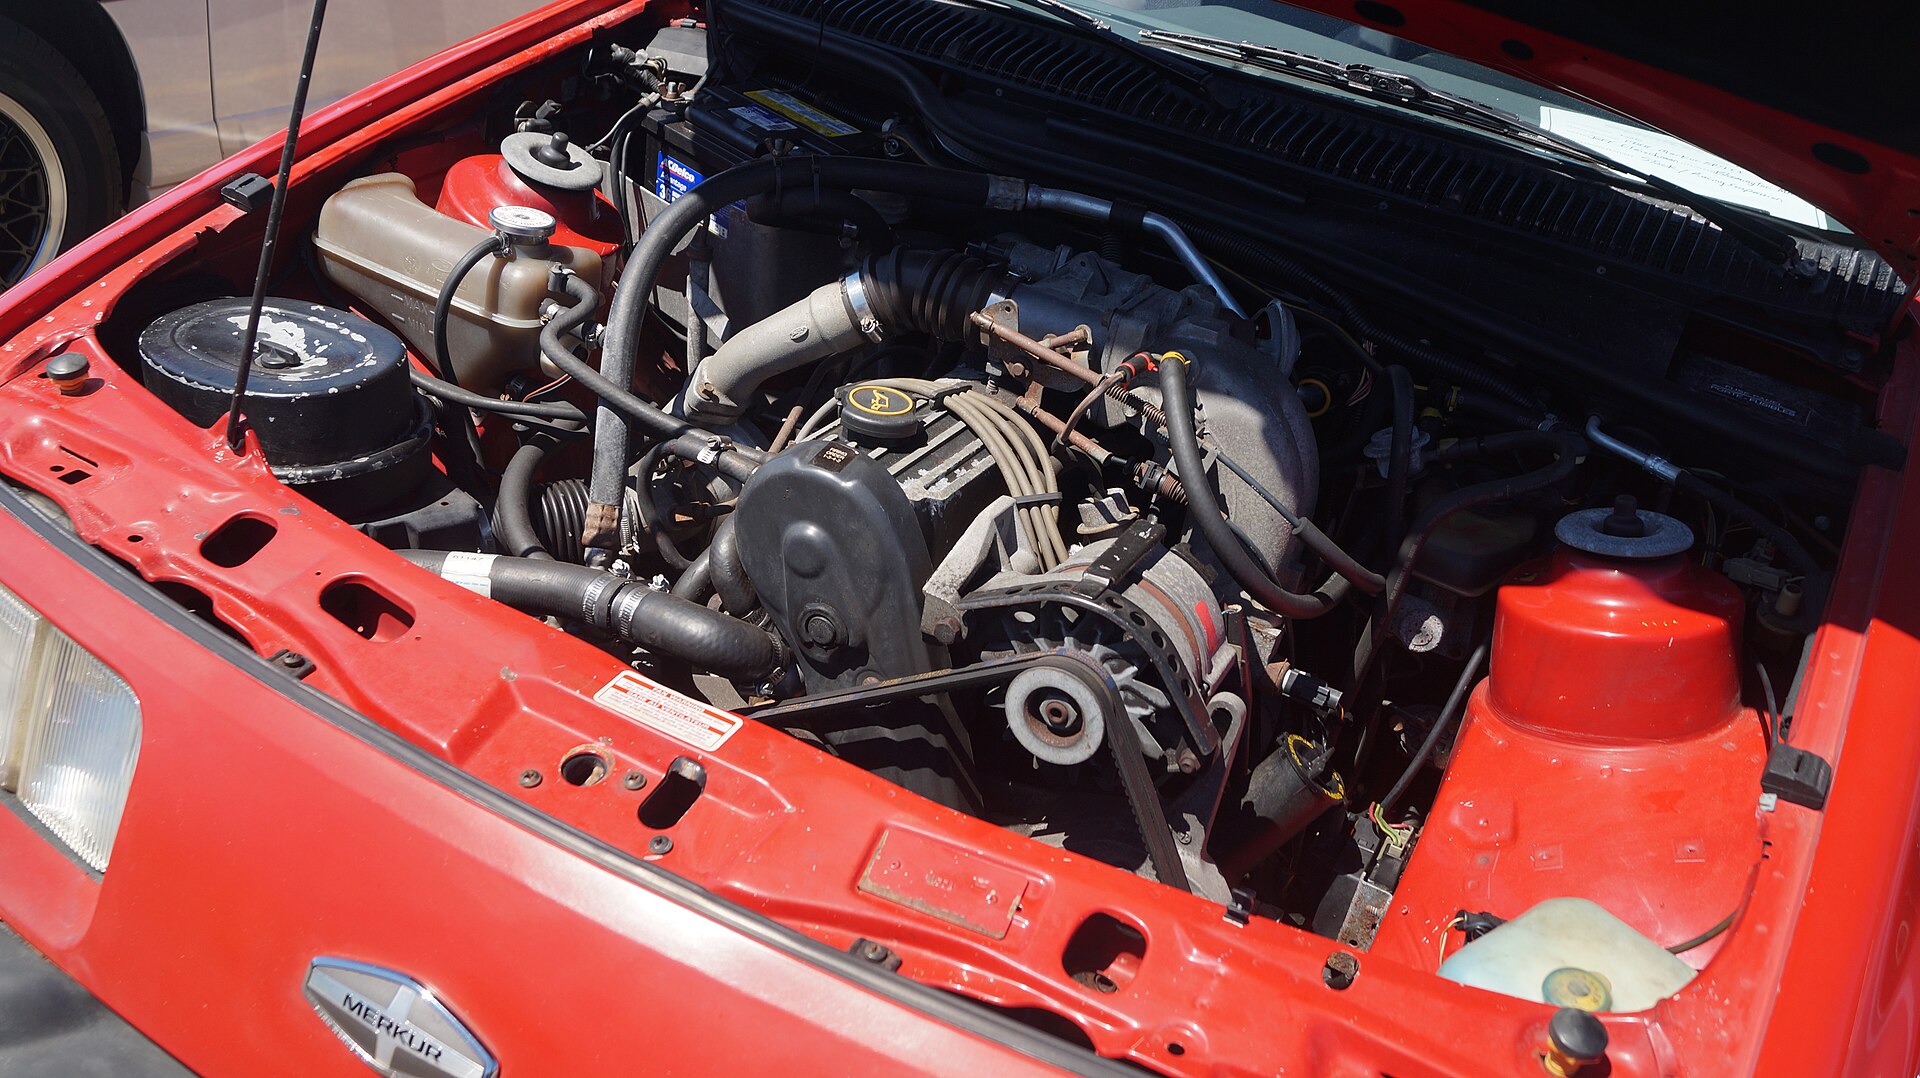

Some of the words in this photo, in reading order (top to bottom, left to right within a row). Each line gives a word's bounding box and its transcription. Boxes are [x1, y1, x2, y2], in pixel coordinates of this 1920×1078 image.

[661, 158, 695, 182] ACDelco
[404, 296, 428, 315] MAX
[343, 993, 443, 1062] MERKUR
